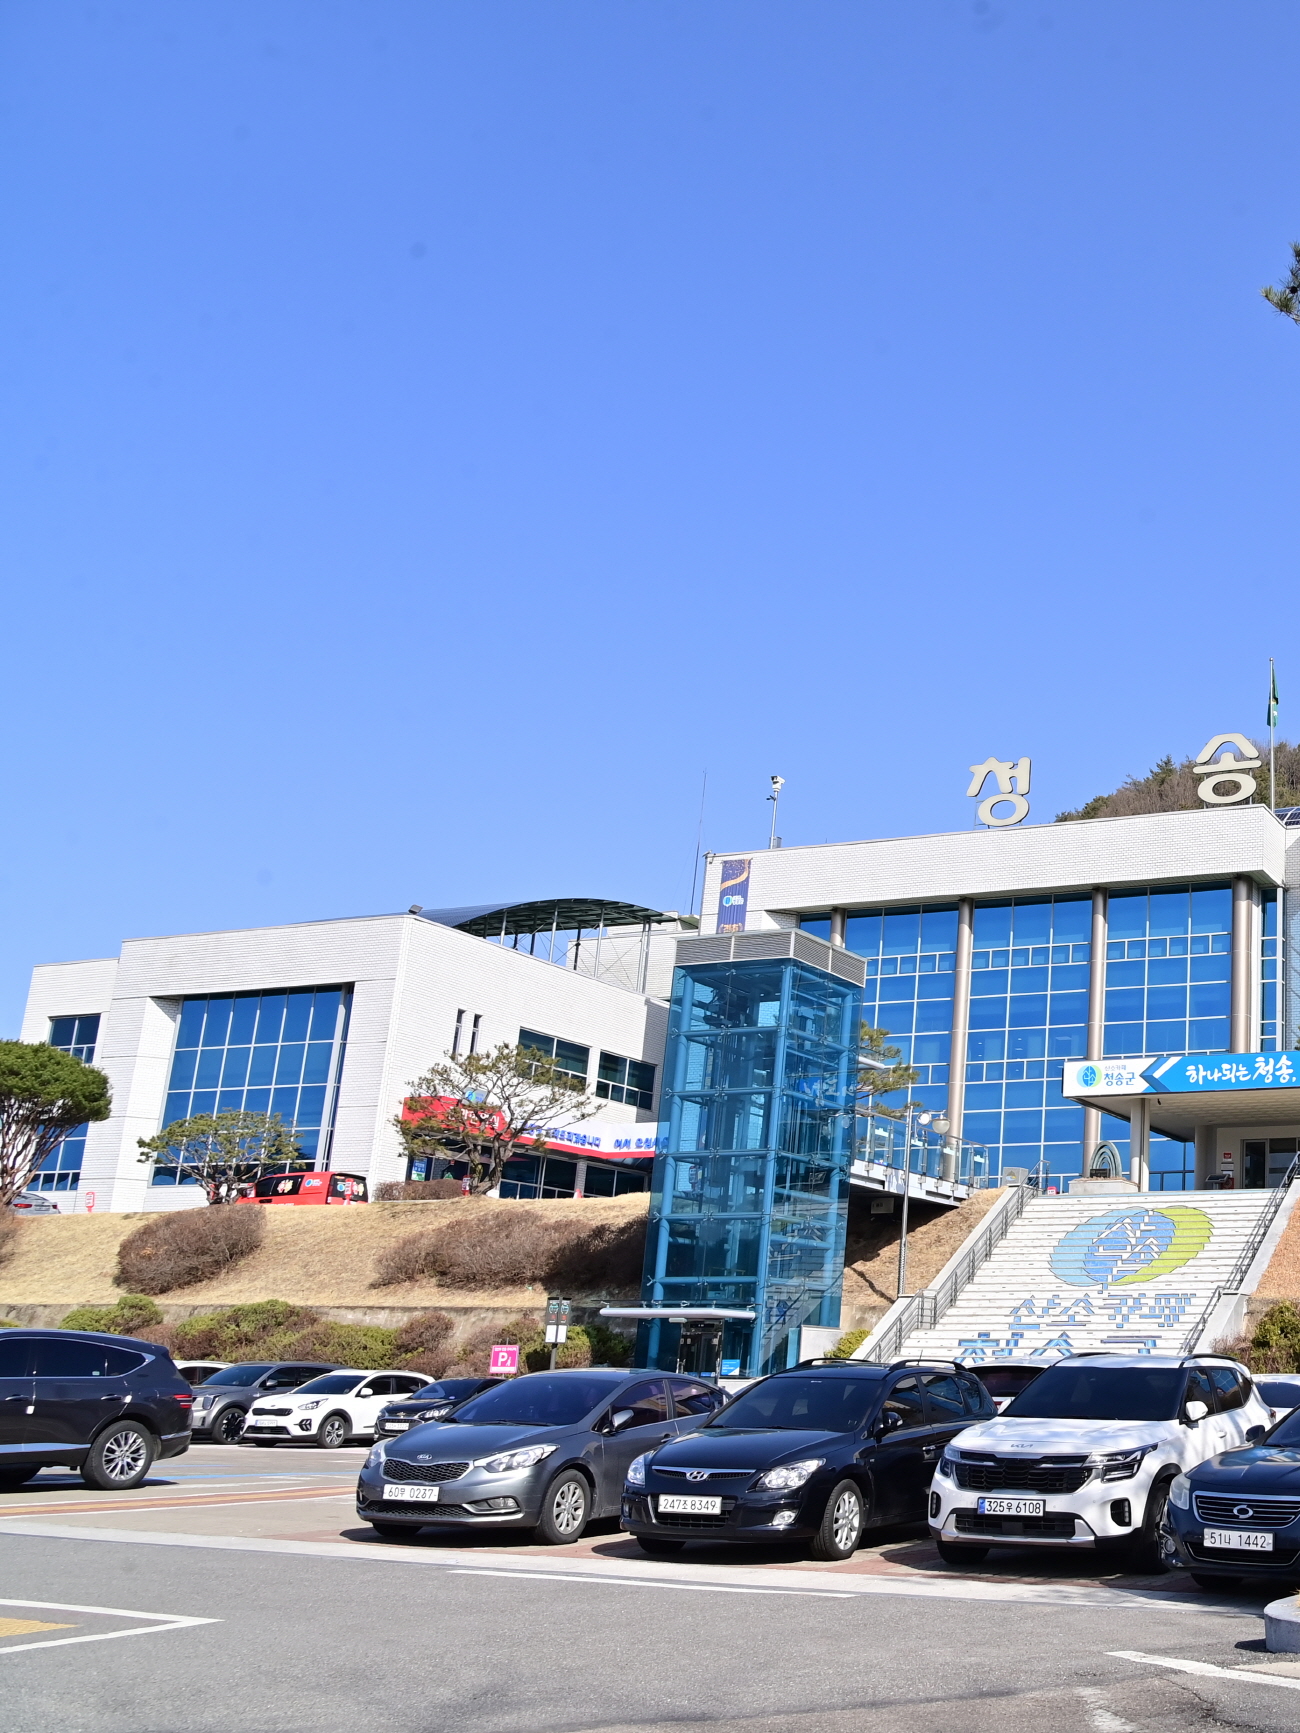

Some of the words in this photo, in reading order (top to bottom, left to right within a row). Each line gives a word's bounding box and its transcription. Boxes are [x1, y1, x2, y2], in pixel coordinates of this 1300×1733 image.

[1185, 1062, 1252, 1085] 하나되는
[1252, 1054, 1297, 1083] 청송,
[1103, 1072, 1136, 1087] 청송군
[986, 1500, 1013, 1513] 325우
[1015, 1502, 1041, 1515] 6108
[1237, 1534, 1266, 1549] 1442
